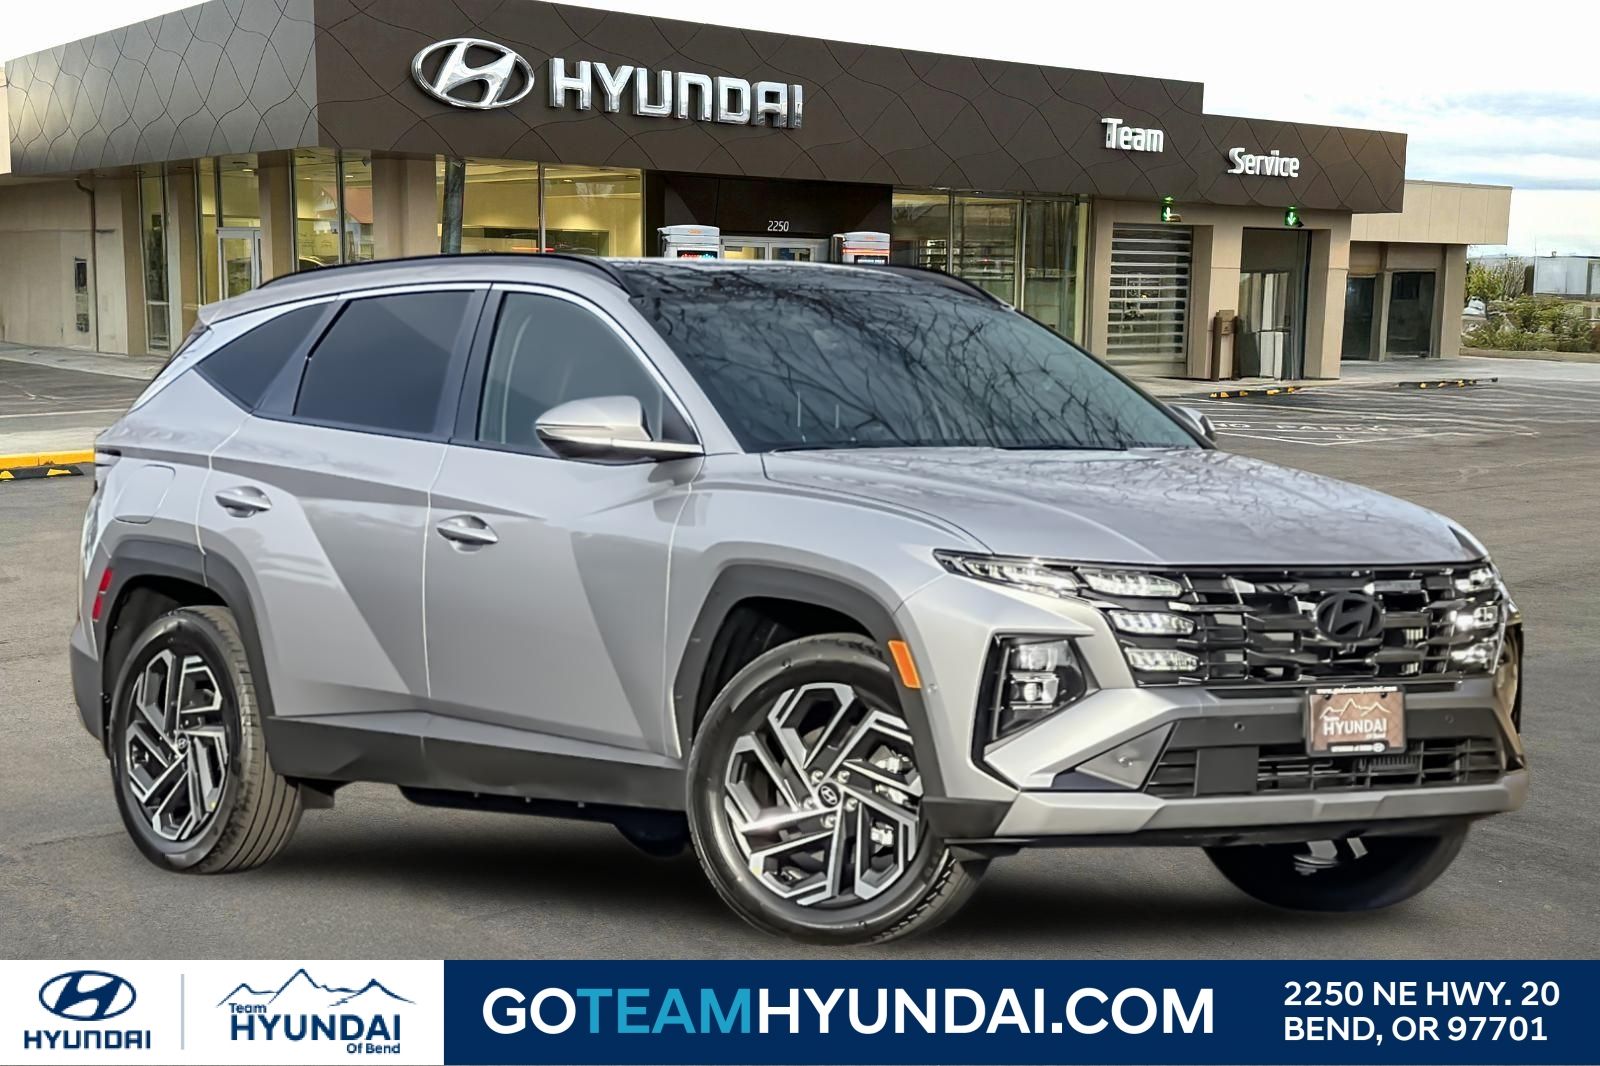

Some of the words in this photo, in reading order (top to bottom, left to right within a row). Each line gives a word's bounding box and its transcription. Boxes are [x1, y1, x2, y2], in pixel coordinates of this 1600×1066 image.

[549, 57, 803, 129] HYUNDAI
[1101, 117, 1164, 152] Team
[1227, 147, 1300, 178] Service
[767, 219, 790, 232] 2250
[1323, 718, 1388, 736] HYUNDAI
